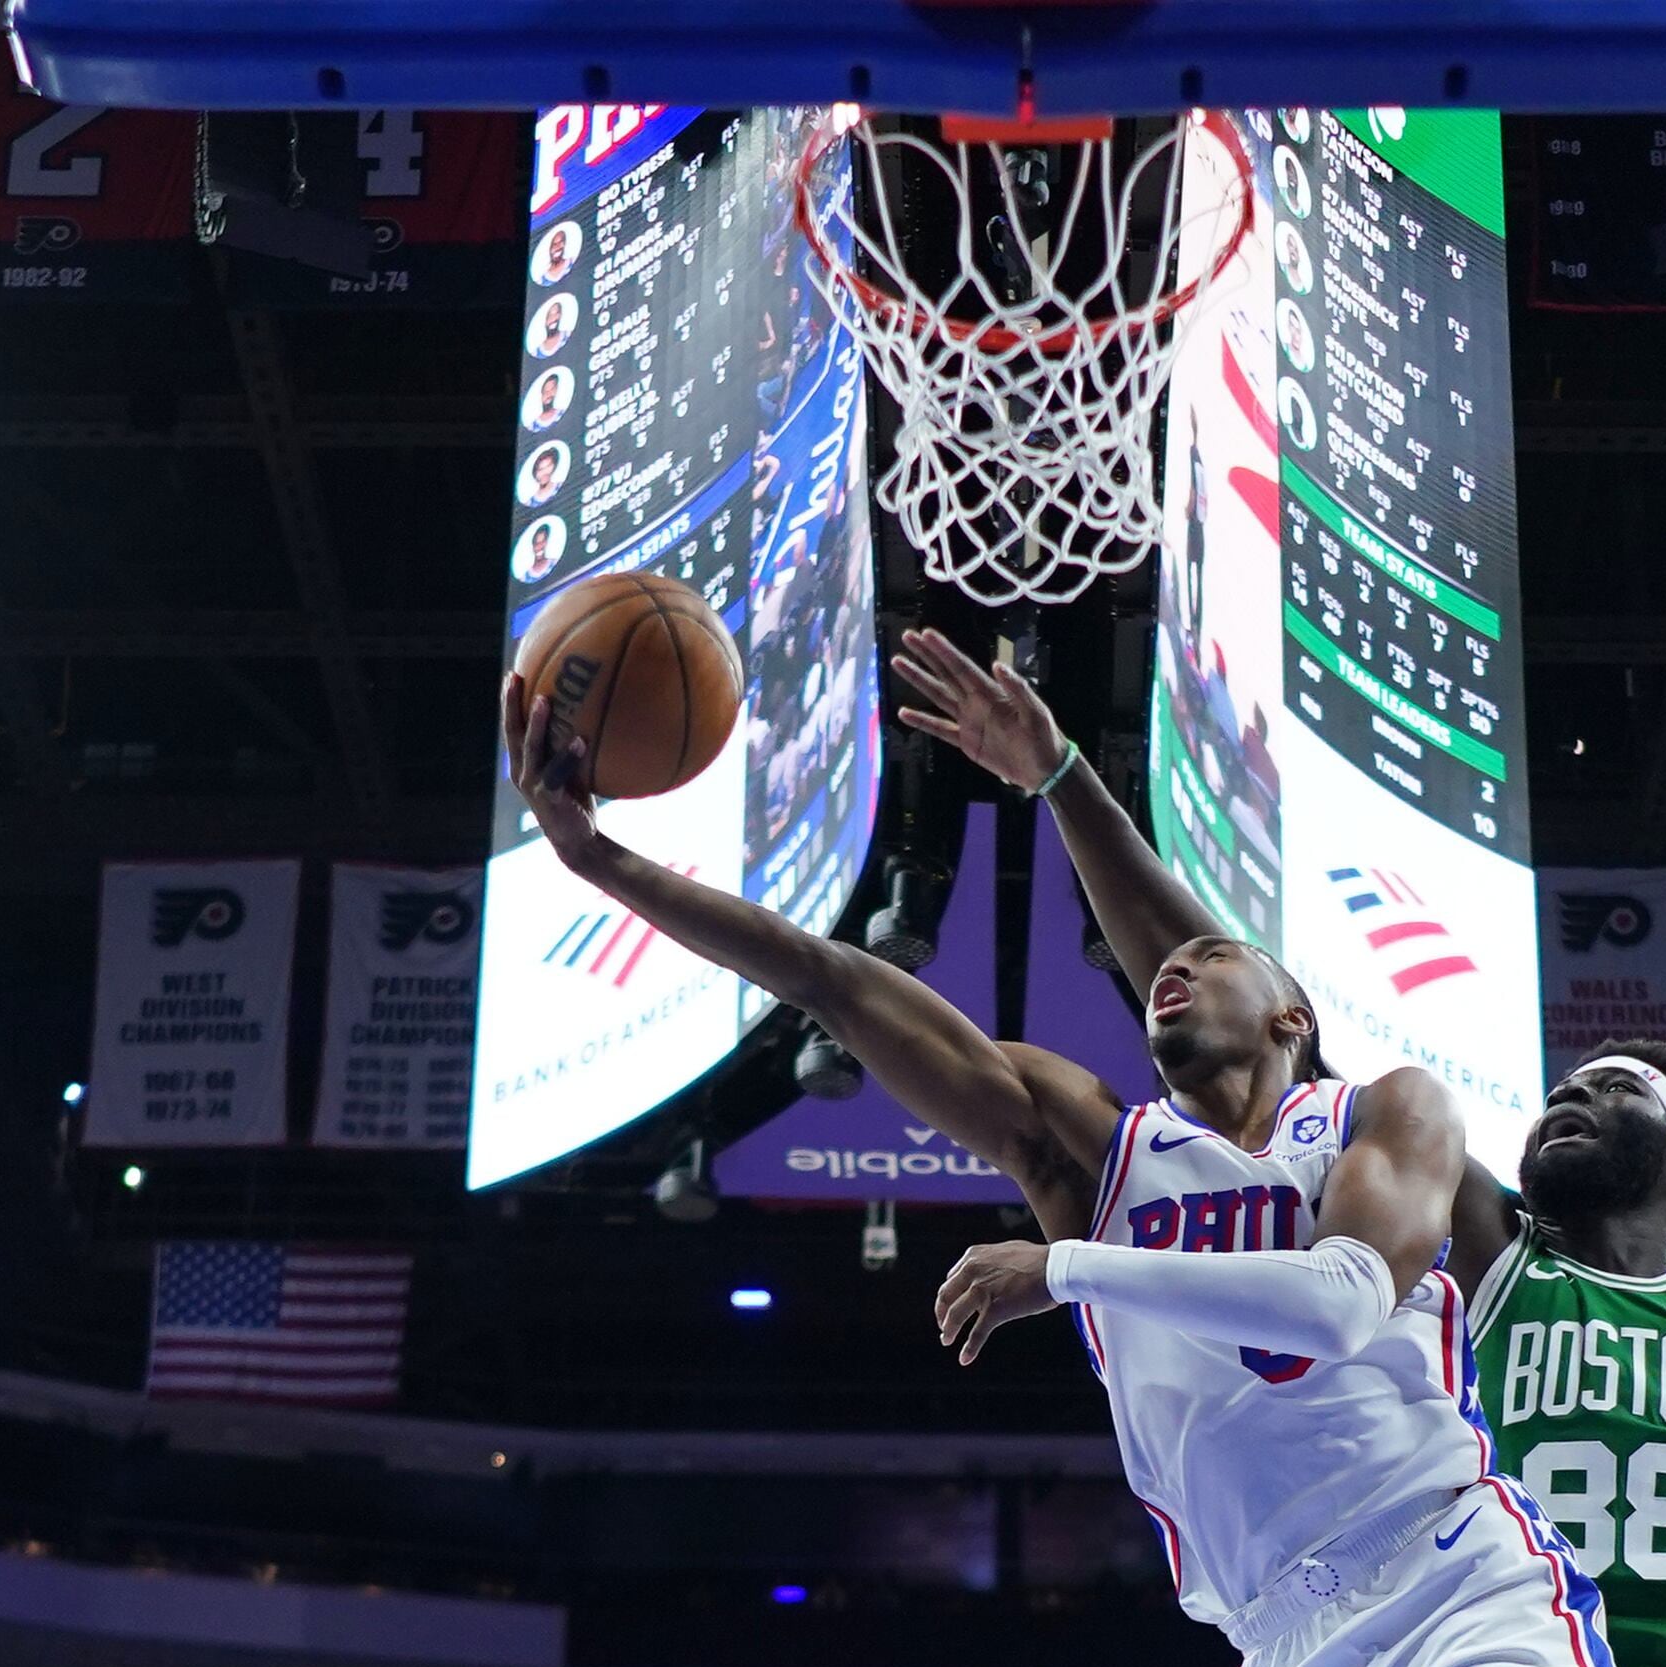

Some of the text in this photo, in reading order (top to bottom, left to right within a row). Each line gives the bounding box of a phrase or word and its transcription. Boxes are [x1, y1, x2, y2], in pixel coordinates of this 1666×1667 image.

[1321, 127, 1369, 182] TATUM
[1339, 125, 1393, 183] JAYSON
[597, 178, 652, 225] MAXEY
[1322, 201, 1374, 257] BROWN
[1339, 201, 1390, 252] JAYLEN
[1324, 276, 1368, 327] WHITE
[1340, 272, 1400, 332] DERRICK
[1326, 352, 1404, 426] PRITCHARD
[1346, 350, 1405, 409] PAYTON
[1327, 431, 1374, 481] QUETA
[1353, 429, 1416, 491] NEEMIAS
[581, 451, 674, 523] EDGECOMBE
[1341, 517, 1437, 600] TEAM STATS
[1338, 654, 1451, 747] TEAM LEADERS
[141, 998, 245, 1020] DIVISION
[162, 973, 227, 995] WEST
[1571, 980, 1648, 1001] WALES
[120, 1021, 262, 1045] CHAMPIONS
[351, 1024, 474, 1047] CHAMPION
[493, 1054, 572, 1104] BANK
[578, 1034, 616, 1066] OF
[1364, 1013, 1394, 1053] OF
[1400, 1036, 1525, 1115] AMERICA
